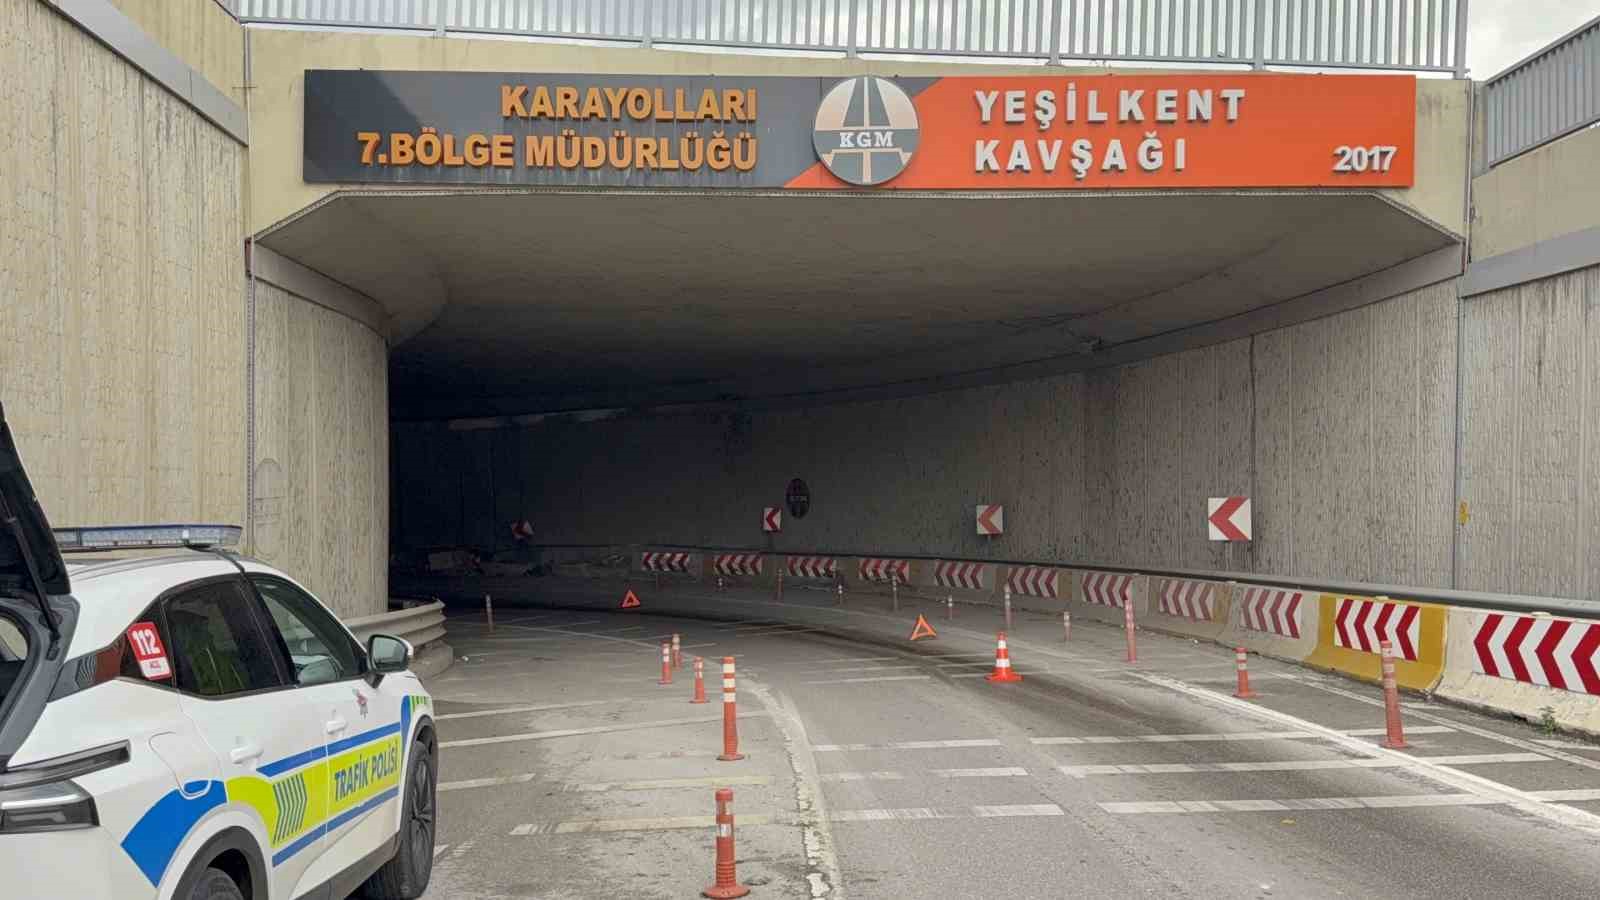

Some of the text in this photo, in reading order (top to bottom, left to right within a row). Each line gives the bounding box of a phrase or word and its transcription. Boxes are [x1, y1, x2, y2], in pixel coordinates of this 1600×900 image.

[501, 85, 757, 120] KARAYOLLARI
[975, 82, 1245, 130] YEŞİLKENT
[357, 127, 757, 170] 7.BÖLGE MÜDÜRLÜĞÜ
[840, 131, 894, 148] KGM
[975, 131, 1186, 178] KAVŞAĞI
[1332, 145, 1398, 172] 2017
[132, 629, 161, 656] 112
[335, 738, 399, 801] TRAFİK POLİSİ
